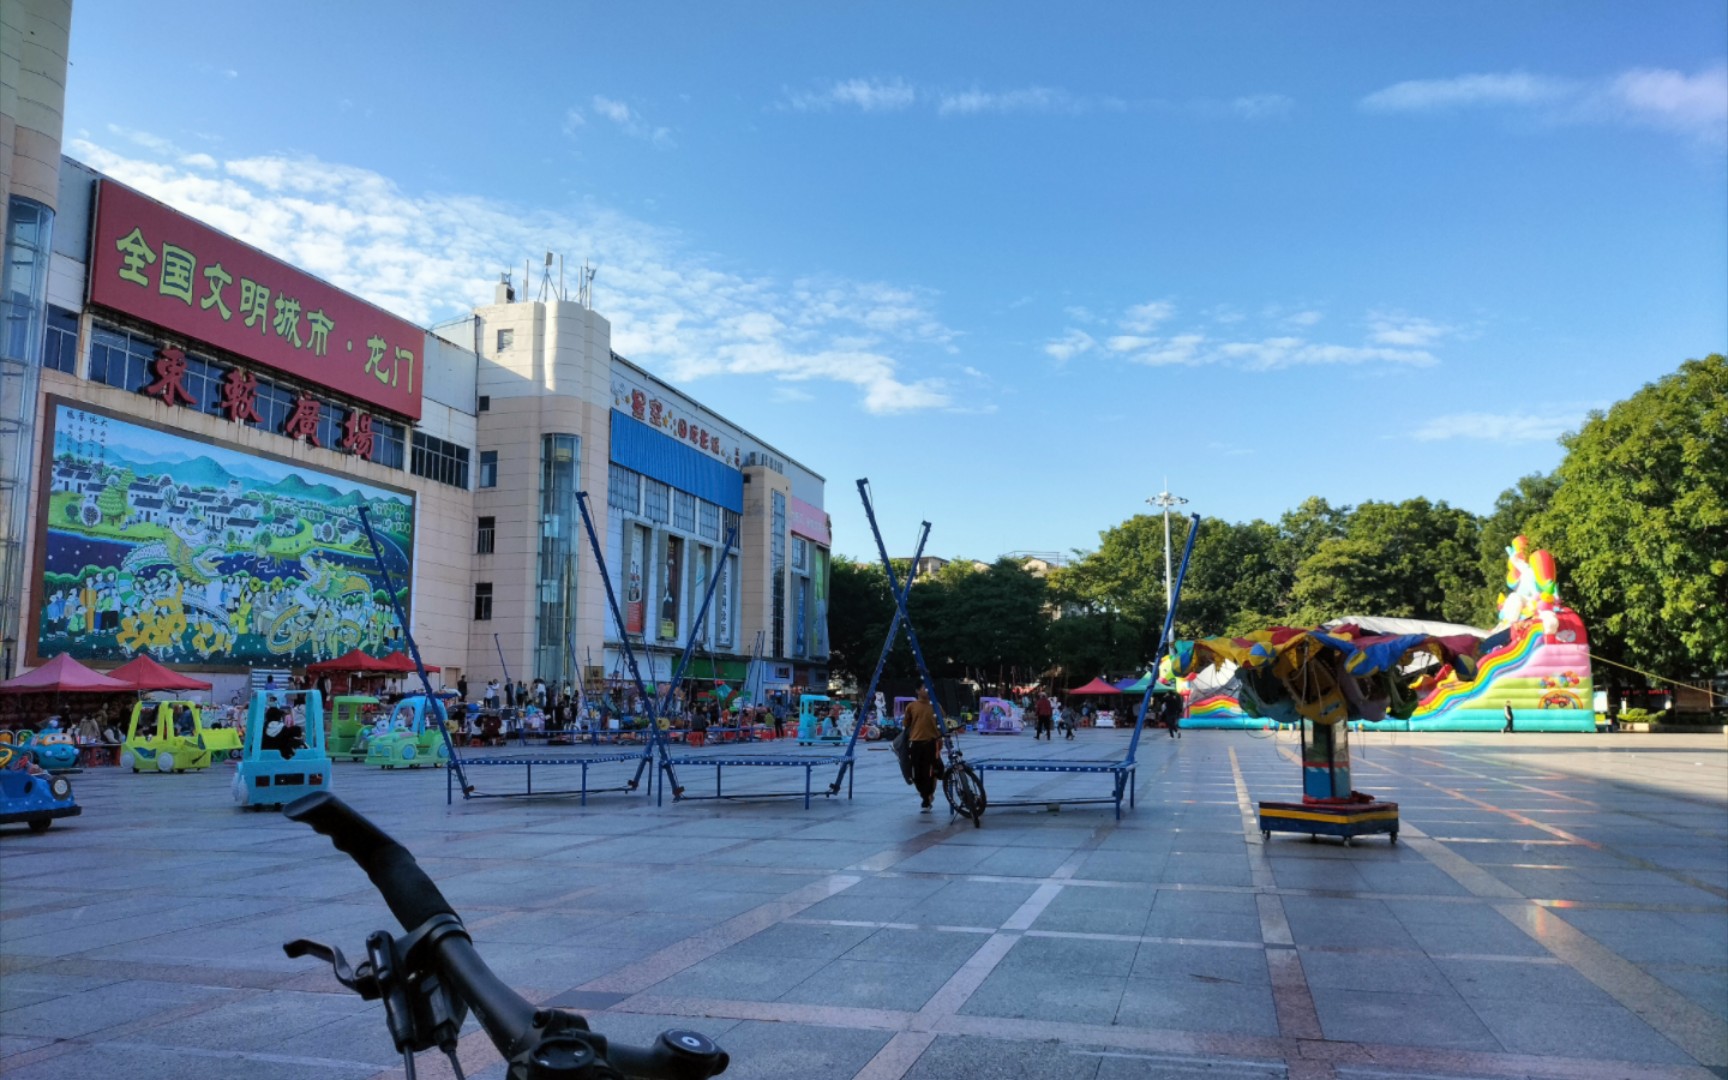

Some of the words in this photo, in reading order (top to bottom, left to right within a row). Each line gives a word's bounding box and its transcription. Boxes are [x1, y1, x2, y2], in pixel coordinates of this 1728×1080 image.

[116, 227, 415, 394] 全国文明城市·龙门
